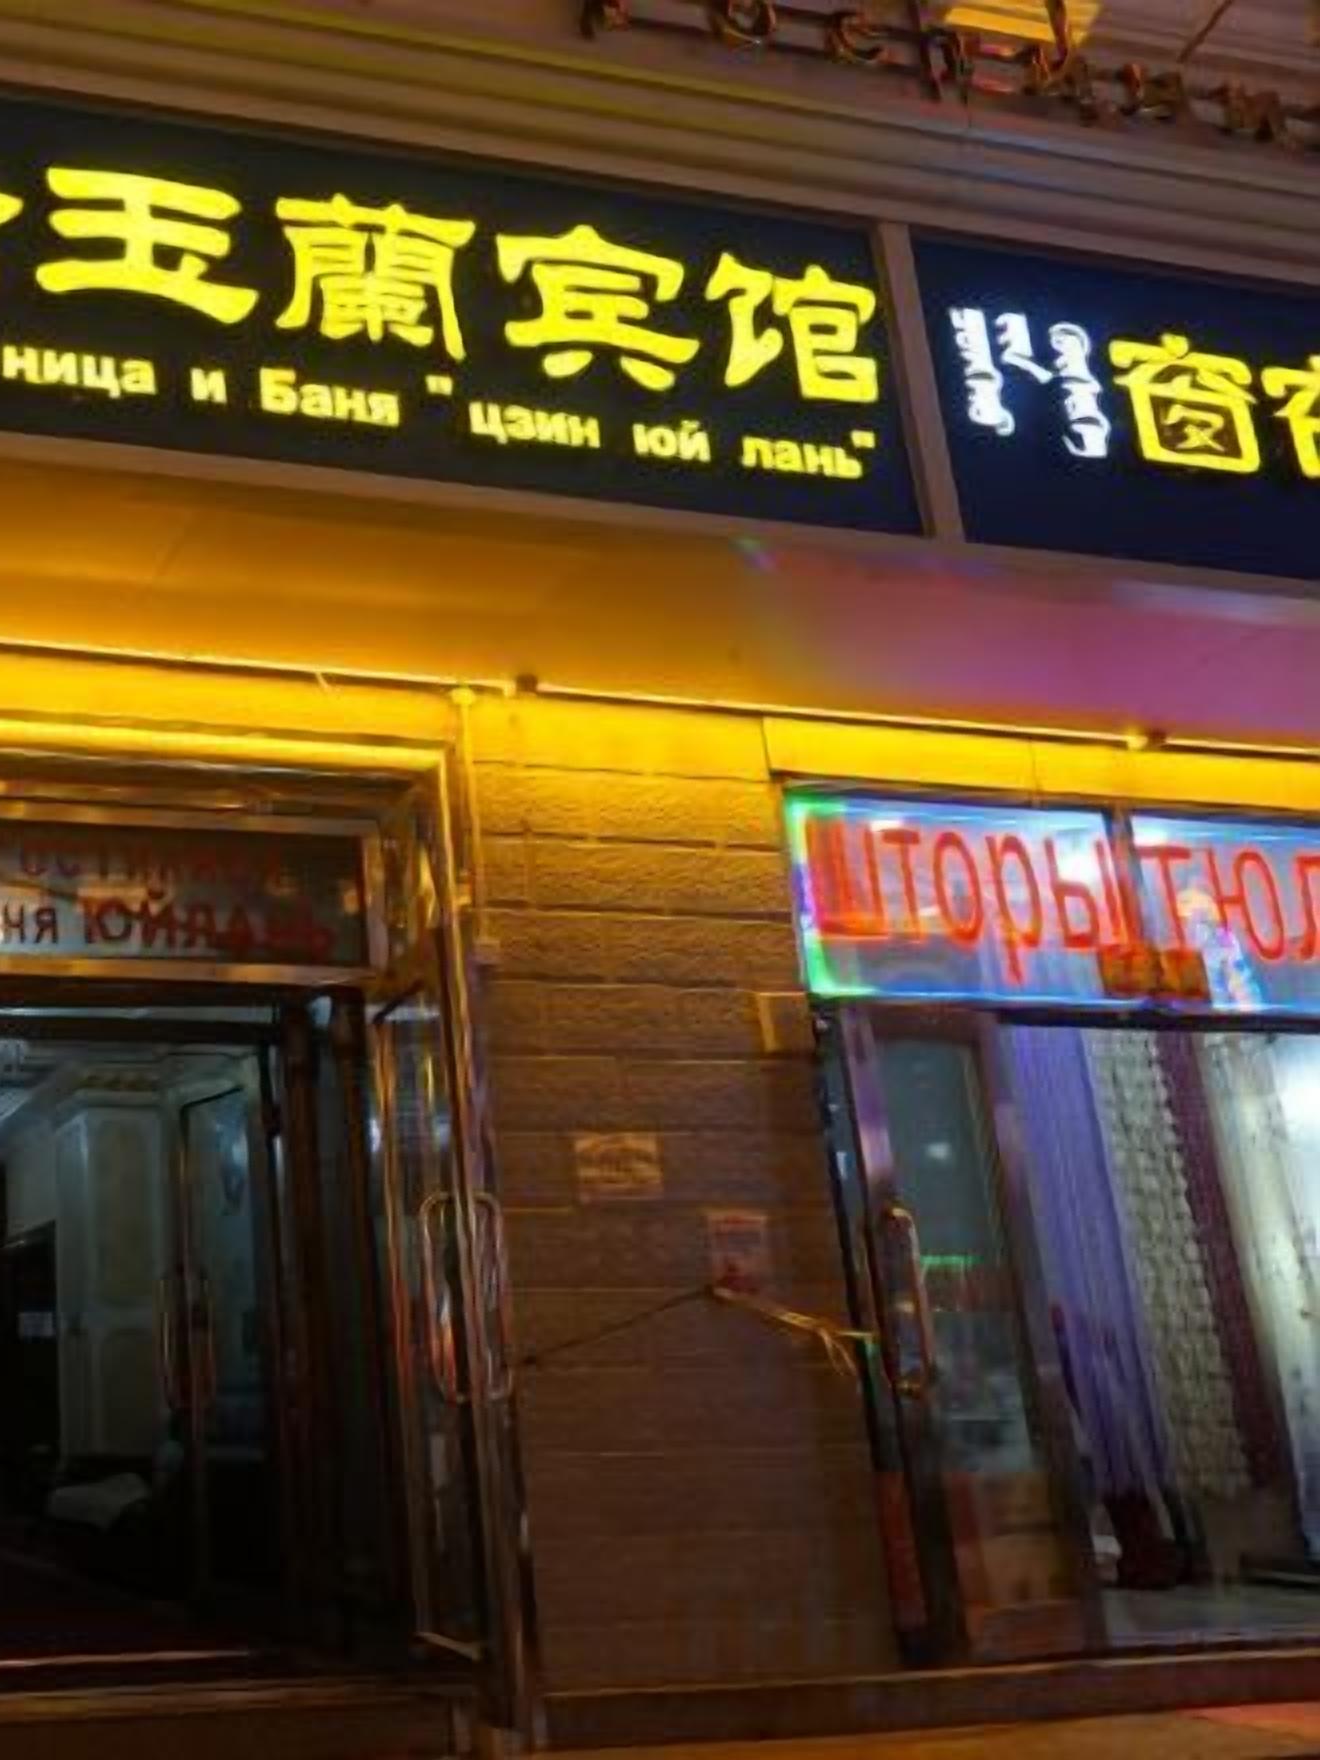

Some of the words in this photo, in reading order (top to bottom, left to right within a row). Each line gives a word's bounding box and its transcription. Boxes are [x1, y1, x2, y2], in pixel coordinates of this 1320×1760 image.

[189, 365, 229, 405] и
[258, 365, 402, 428] Баня
[632, 419, 712, 463] юй
